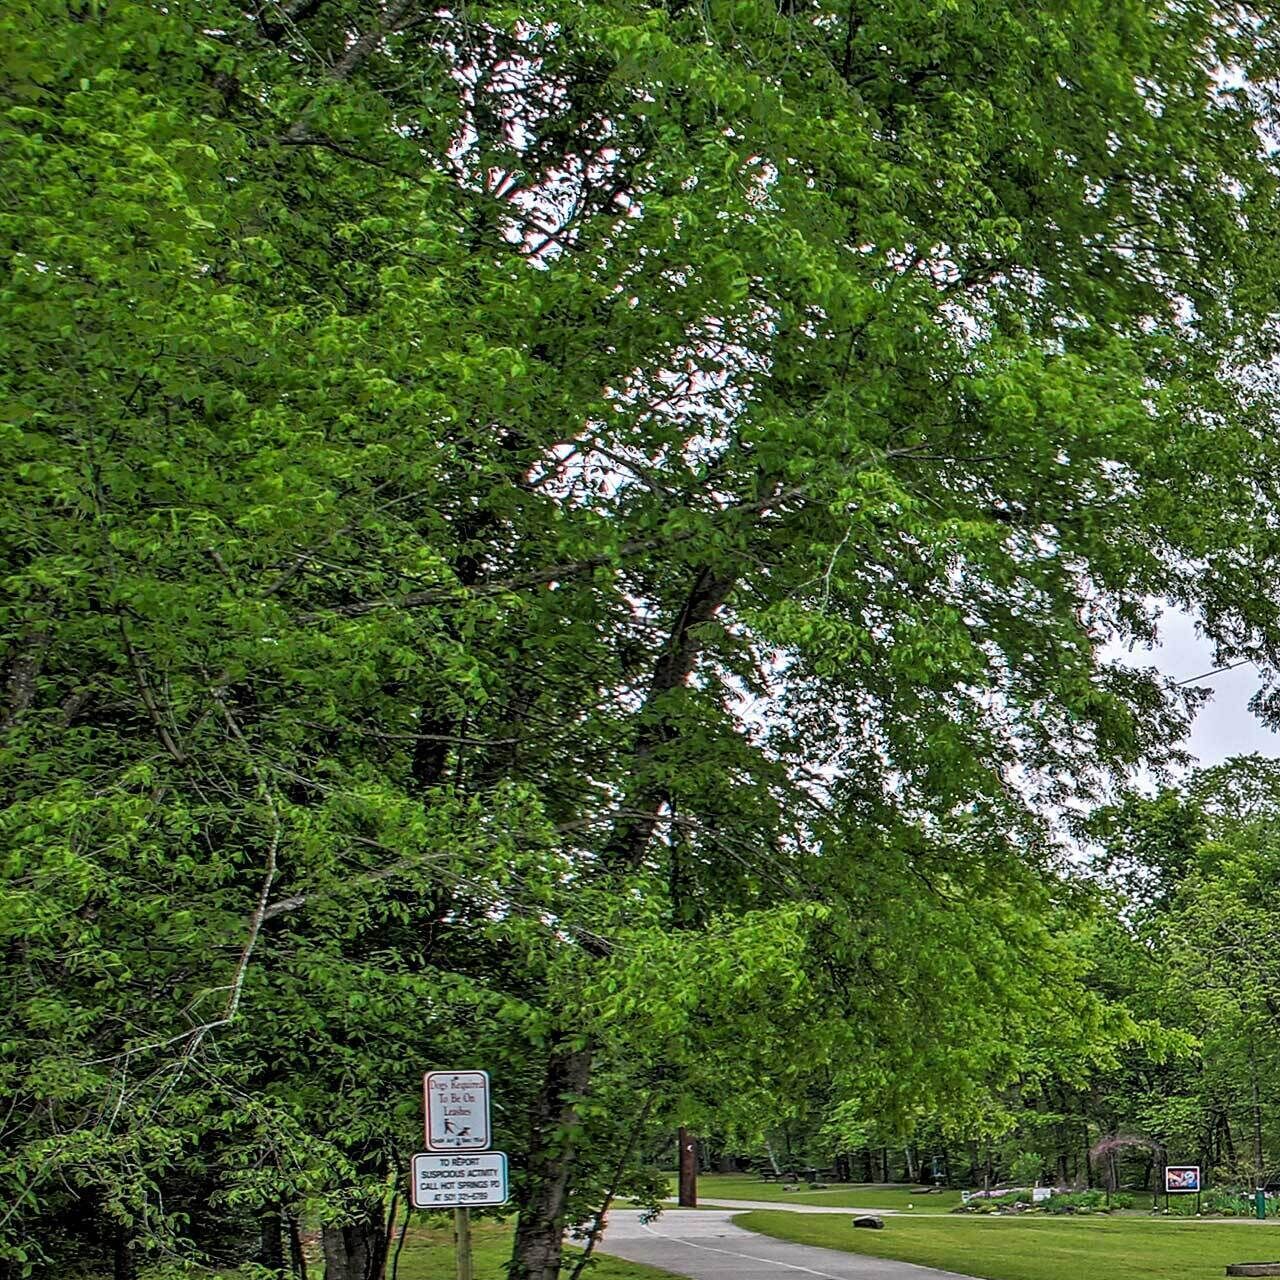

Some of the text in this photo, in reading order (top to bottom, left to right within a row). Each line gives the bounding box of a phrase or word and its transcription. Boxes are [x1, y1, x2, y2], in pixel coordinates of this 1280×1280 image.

[429, 1079, 485, 1091] Dogs Required
[438, 1093, 476, 1103] To Be On
[444, 1105, 471, 1116] Leashes
[440, 1157, 480, 1166] TO REPORT
[421, 1169, 498, 1179] SUSPICIOUS ACTIVITY
[421, 1180, 500, 1190] CALL HOT SPRINGS PD
[434, 1193, 441, 1201] AT
